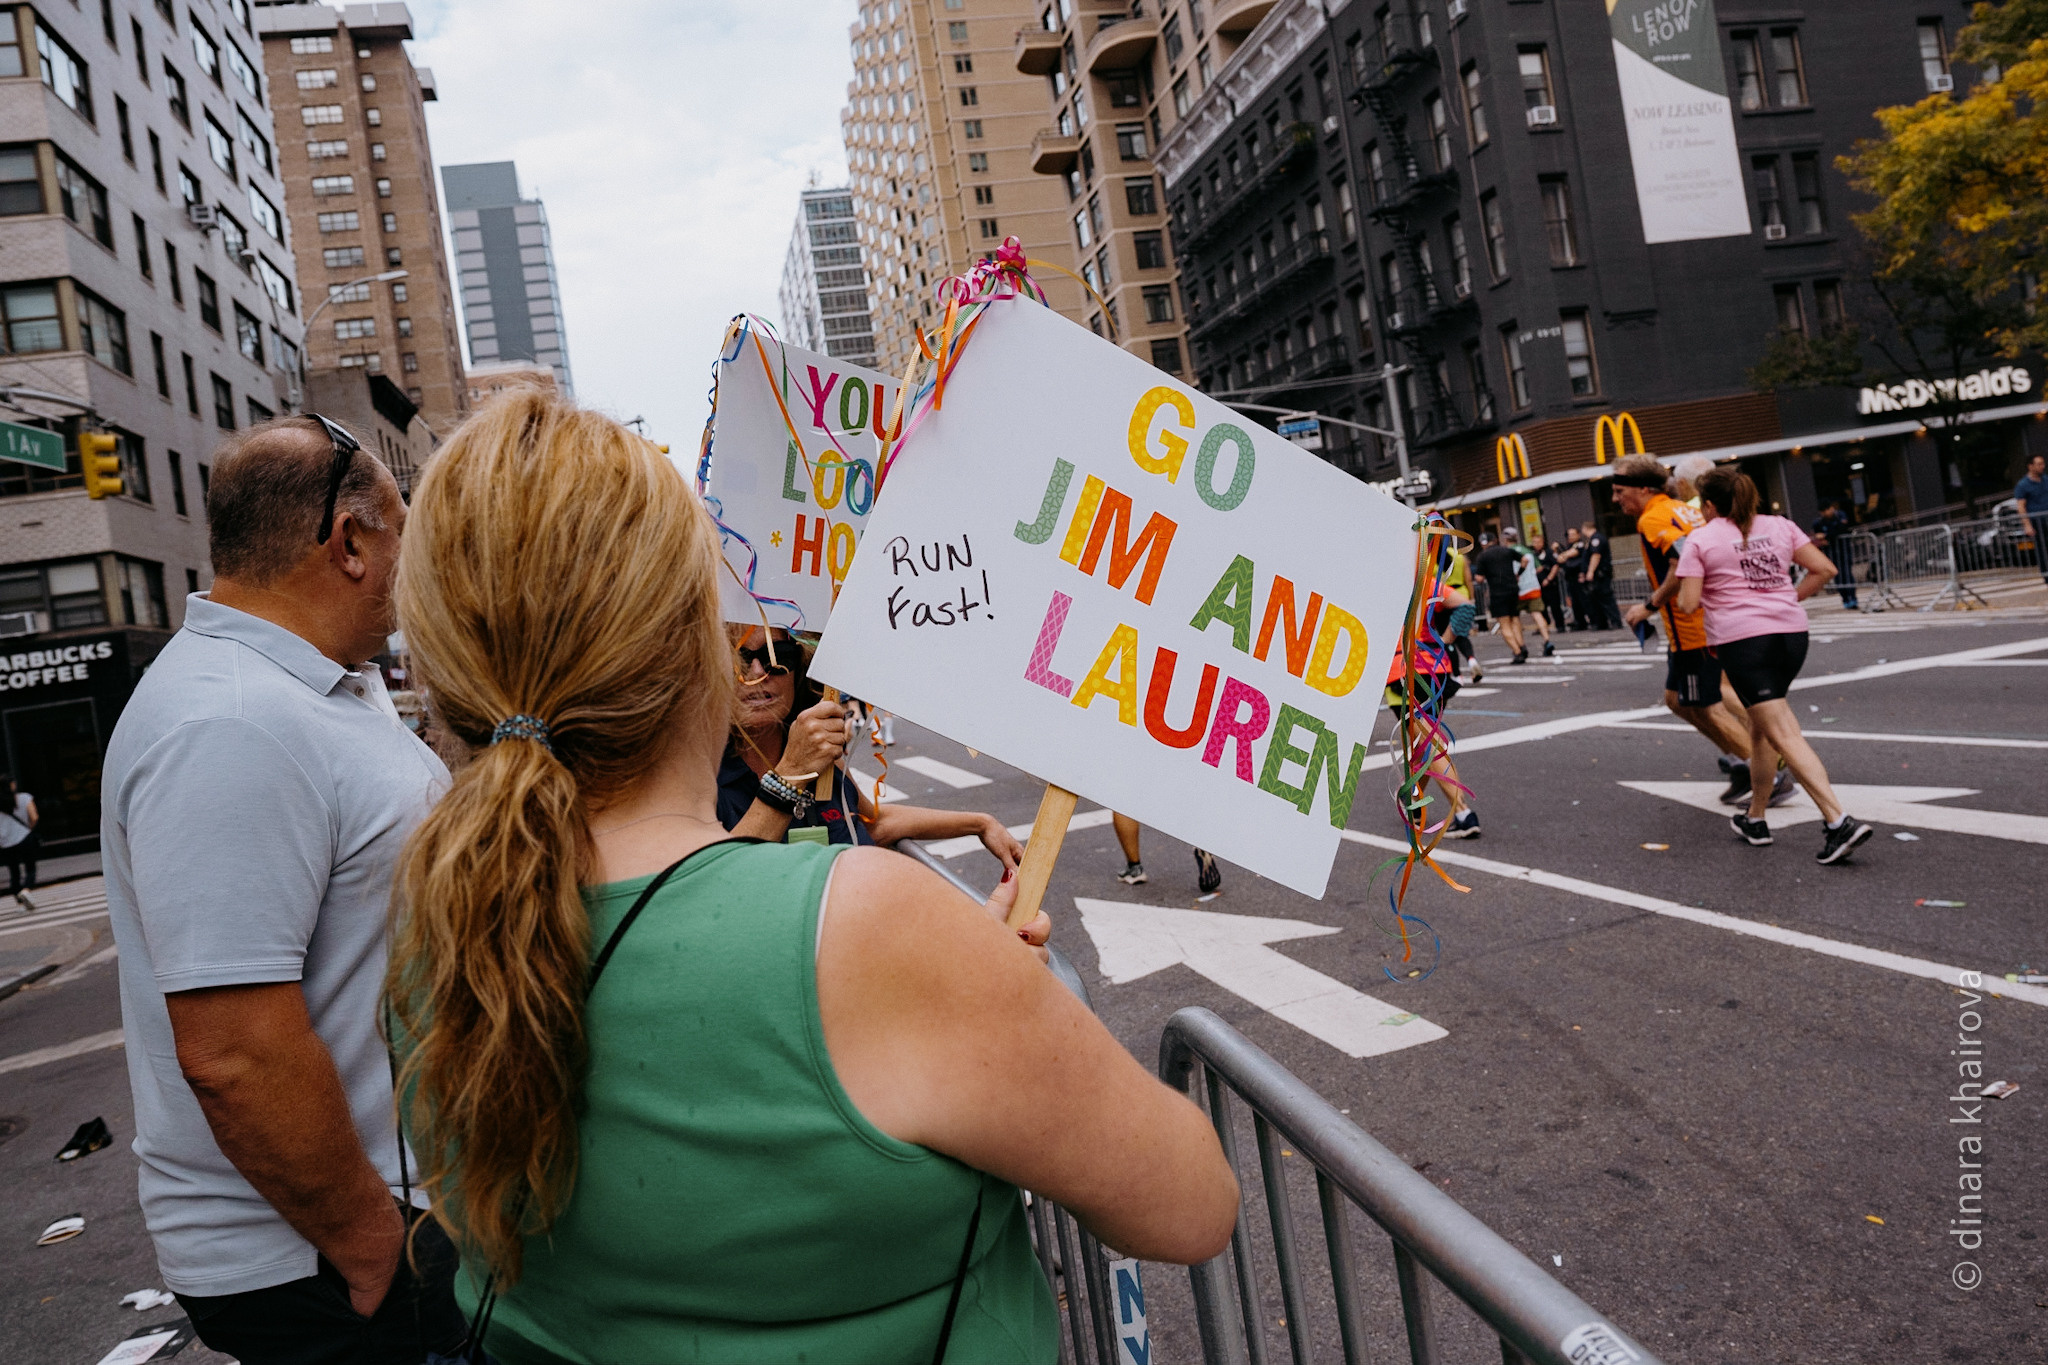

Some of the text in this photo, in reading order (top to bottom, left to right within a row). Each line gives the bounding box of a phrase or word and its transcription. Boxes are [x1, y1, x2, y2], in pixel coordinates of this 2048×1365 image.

[1646, 14, 1690, 47] ROW
[806, 364, 904, 442] YOU
[7, 430, 41, 457] 1 Av
[1127, 385, 1256, 512] GO
[791, 514, 866, 583] HO
[883, 533, 974, 577] RUN
[1013, 457, 1369, 698] JIM AND
[1024, 590, 1366, 830] LAUREN
